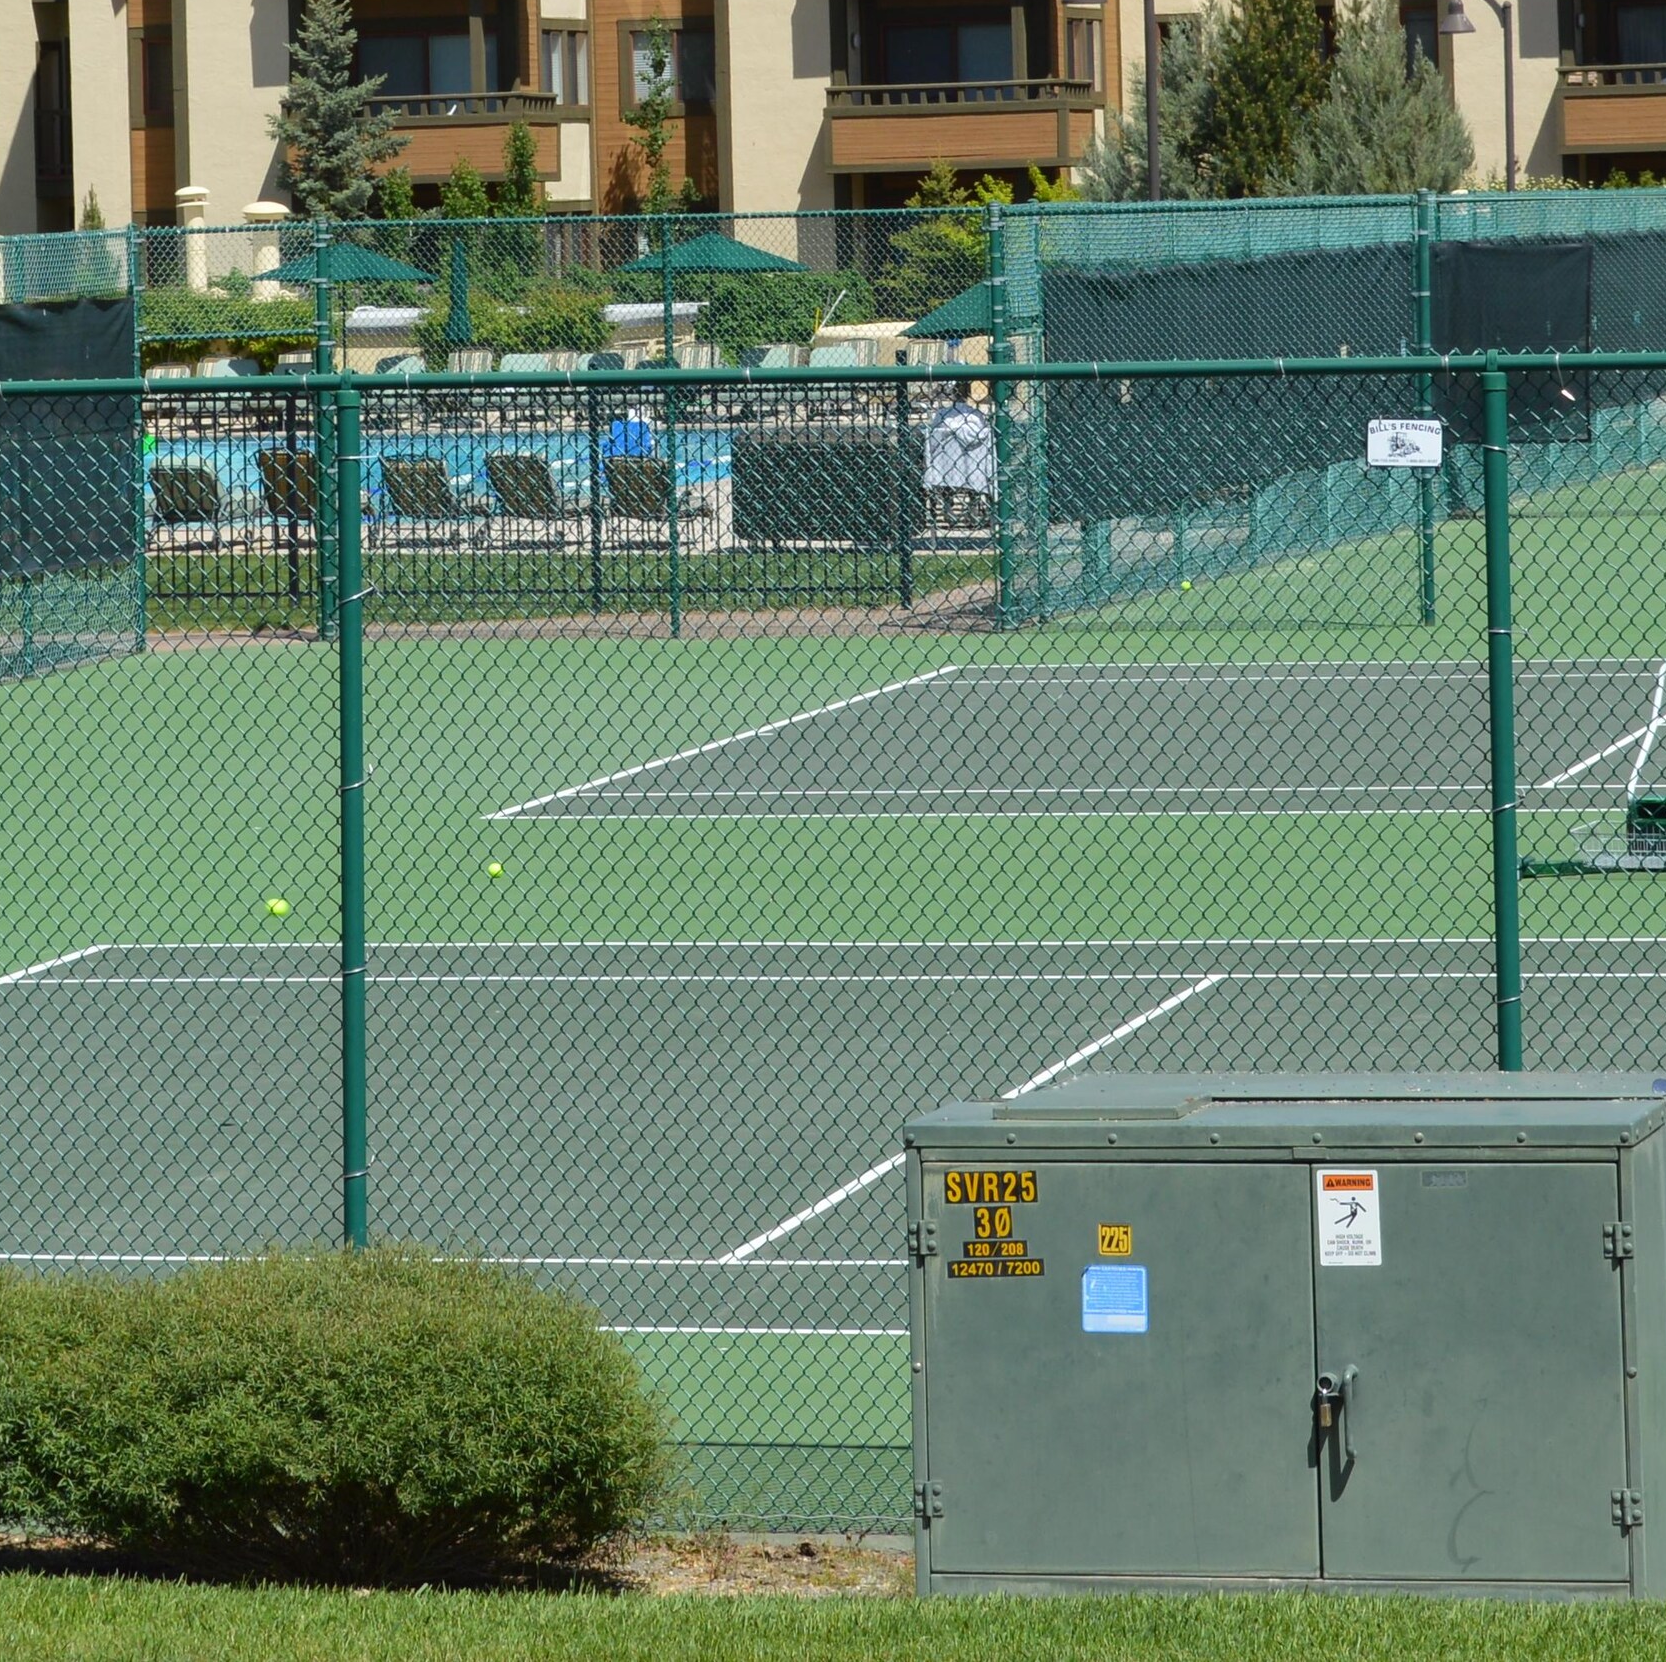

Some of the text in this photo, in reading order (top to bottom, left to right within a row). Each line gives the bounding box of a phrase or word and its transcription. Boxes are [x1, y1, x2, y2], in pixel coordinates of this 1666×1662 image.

[1369, 422, 1441, 435] BILL'S FENCING
[946, 1171, 1035, 1202] SVR25
[1334, 1178, 1371, 1187] WARNING
[1101, 1226, 1128, 1252] 225
